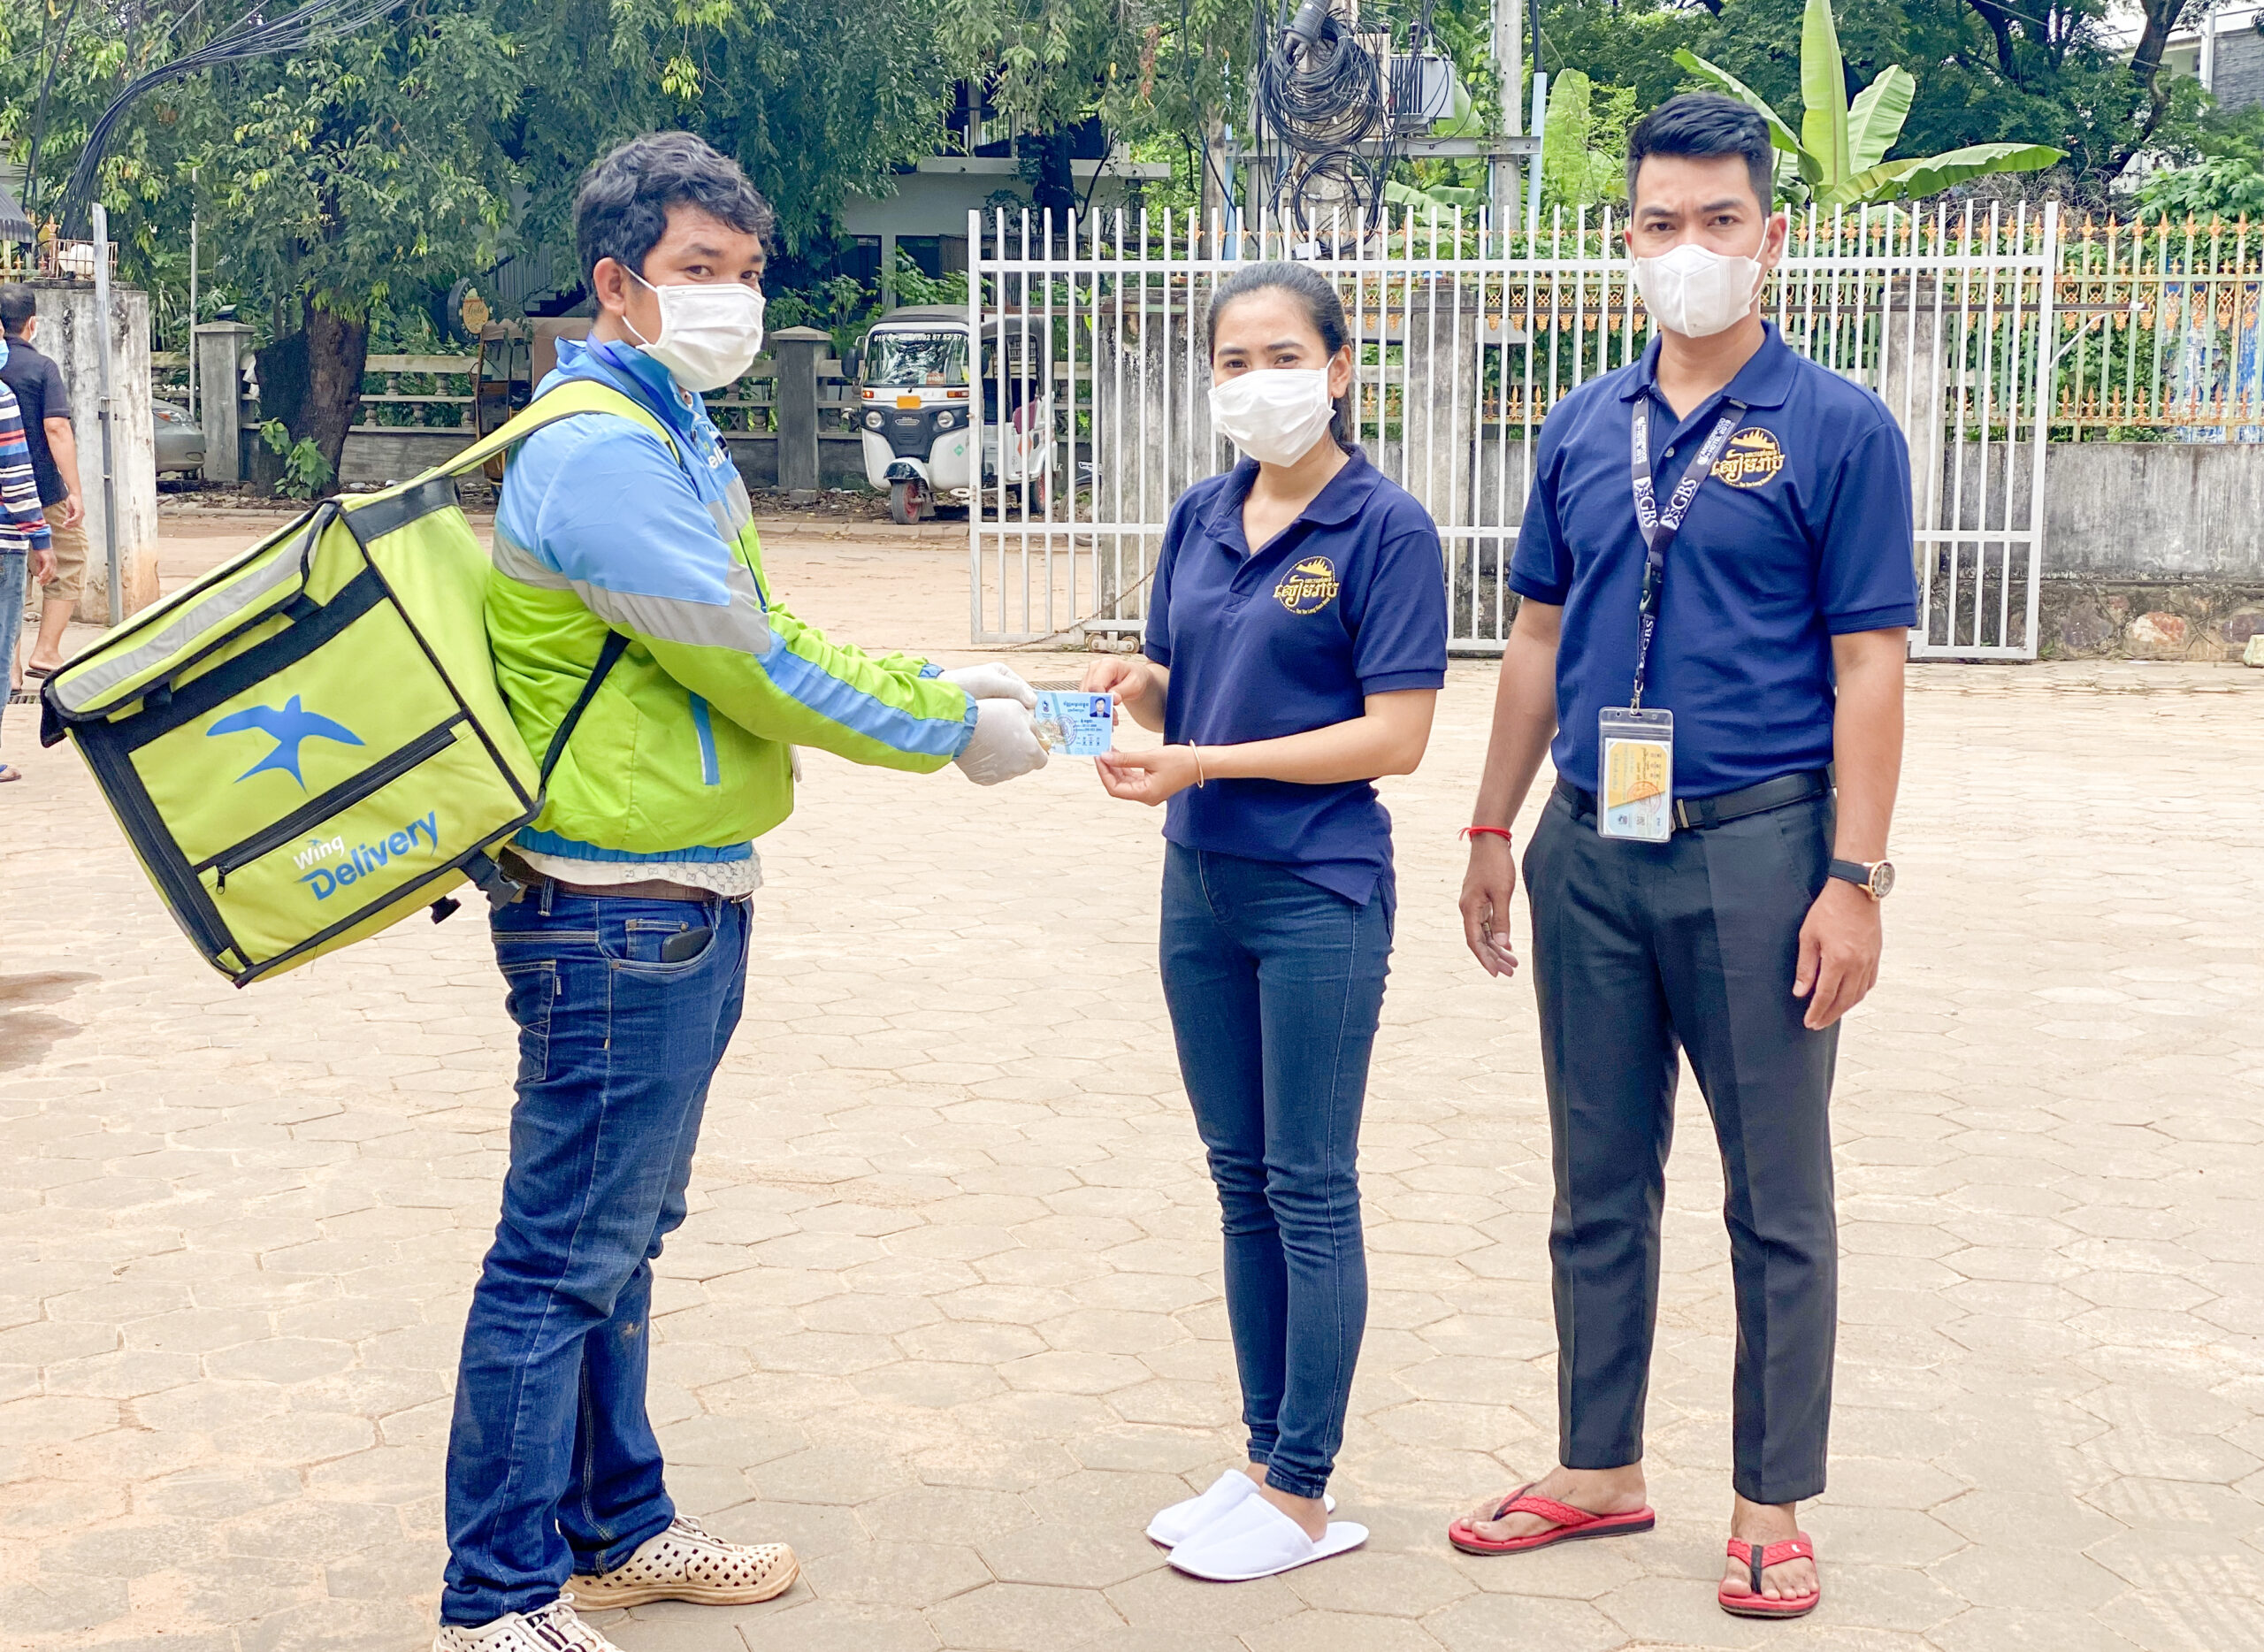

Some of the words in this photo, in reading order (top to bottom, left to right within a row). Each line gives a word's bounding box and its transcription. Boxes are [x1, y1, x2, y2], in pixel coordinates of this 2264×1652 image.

[1671, 477, 1697, 510] GBS
[1639, 495, 1659, 528] GBS
[293, 835, 345, 870] Wing
[294, 810, 439, 901] Delivery
